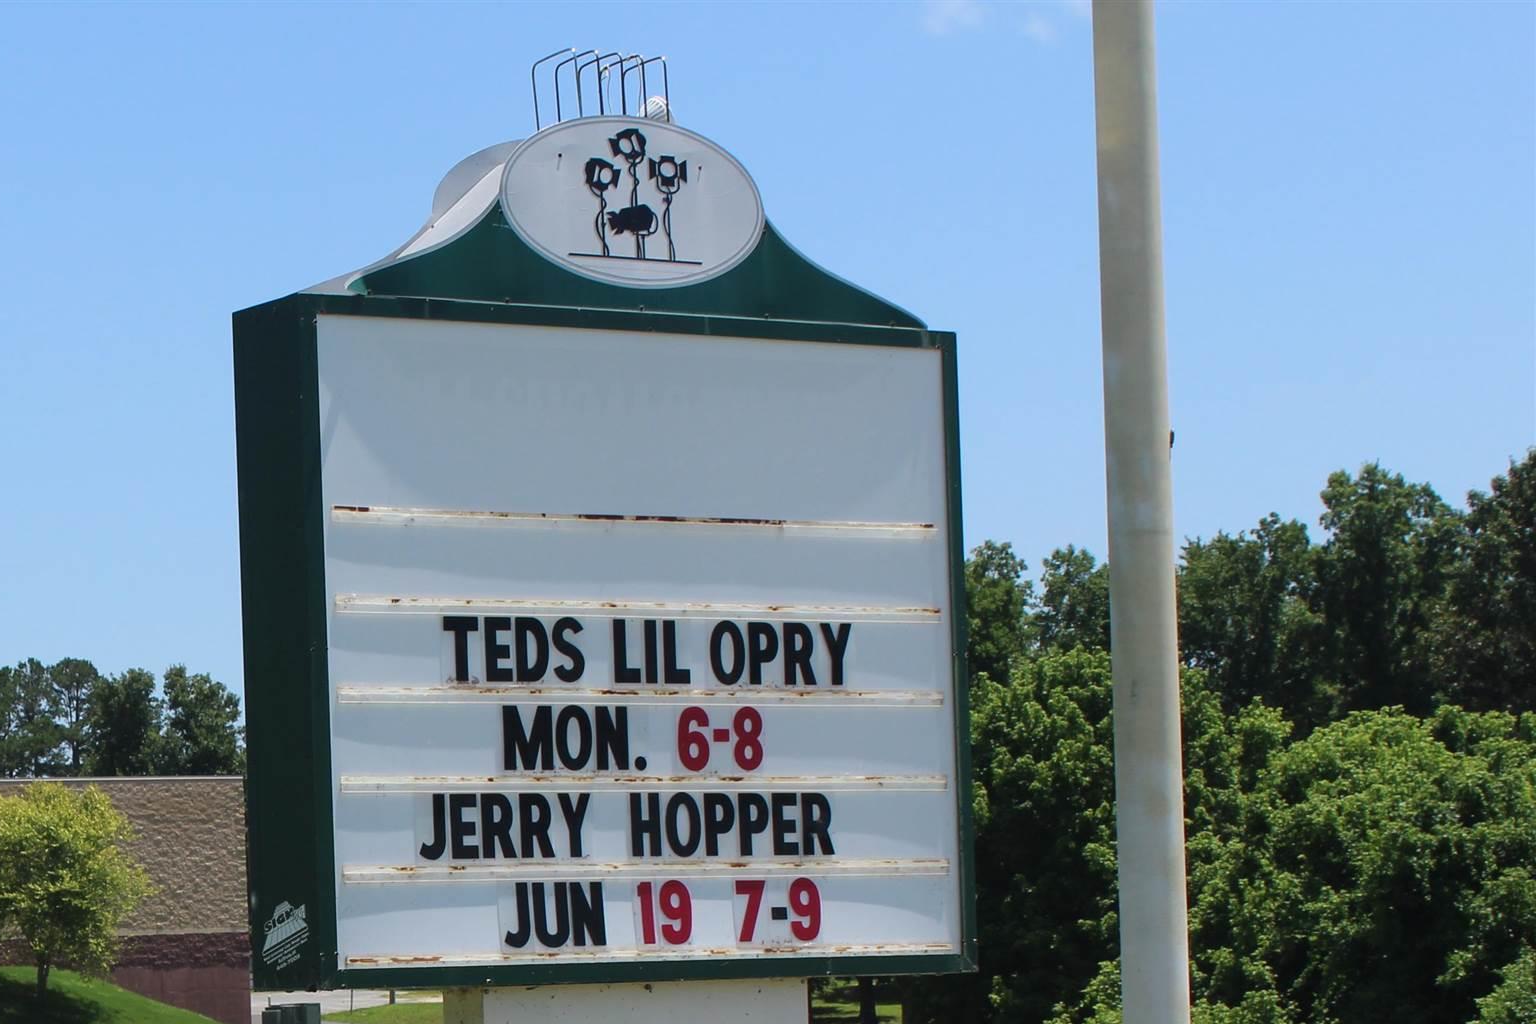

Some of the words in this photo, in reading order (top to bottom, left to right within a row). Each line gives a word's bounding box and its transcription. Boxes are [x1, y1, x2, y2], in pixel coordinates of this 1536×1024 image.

[442, 616, 586, 683] TEDS
[613, 619, 691, 685] LIL
[710, 620, 852, 686] OPRY
[502, 705, 648, 771] MON.
[677, 706, 764, 772] 6-8
[419, 792, 591, 861] JERRY
[629, 792, 835, 858] HOPPER
[504, 881, 607, 949] JUN
[637, 880, 693, 945] 19
[735, 877, 822, 943] 7-9
